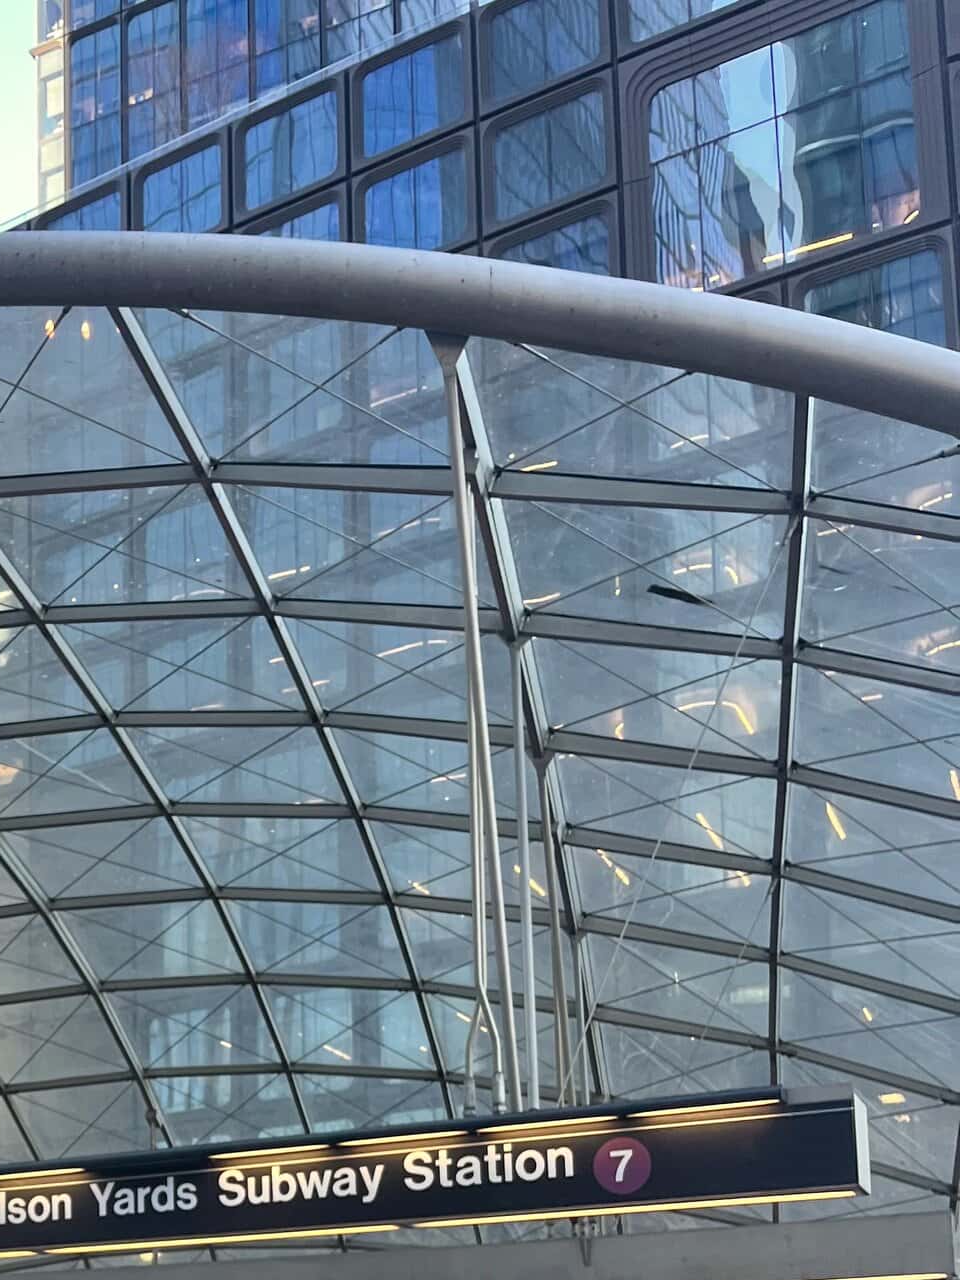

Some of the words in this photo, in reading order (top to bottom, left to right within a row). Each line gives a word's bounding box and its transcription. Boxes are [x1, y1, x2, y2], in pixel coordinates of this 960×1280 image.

[89, 1176, 199, 1217] Yards
[218, 1163, 385, 1207] Subway
[403, 1143, 575, 1191] Station
[609, 1149, 633, 1183] 7
